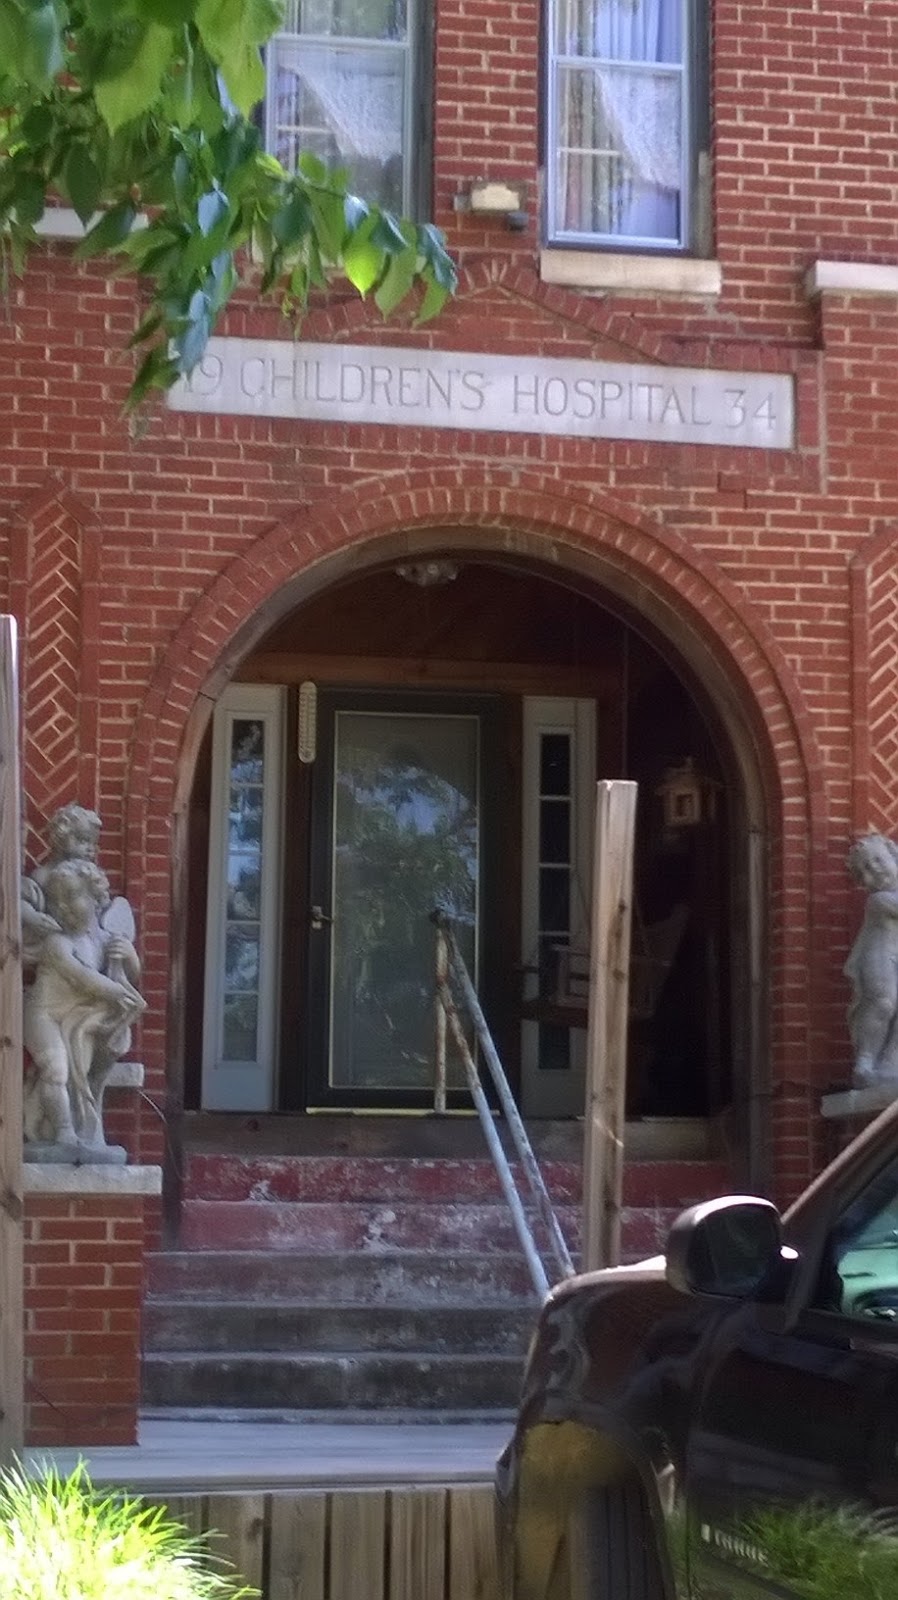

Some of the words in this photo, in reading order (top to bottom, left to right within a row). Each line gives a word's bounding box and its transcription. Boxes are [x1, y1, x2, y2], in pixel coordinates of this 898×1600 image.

[240, 356, 485, 411] CHILDREN'S
[513, 374, 711, 426] HOSPITAL
[723, 388, 776, 430] 34
